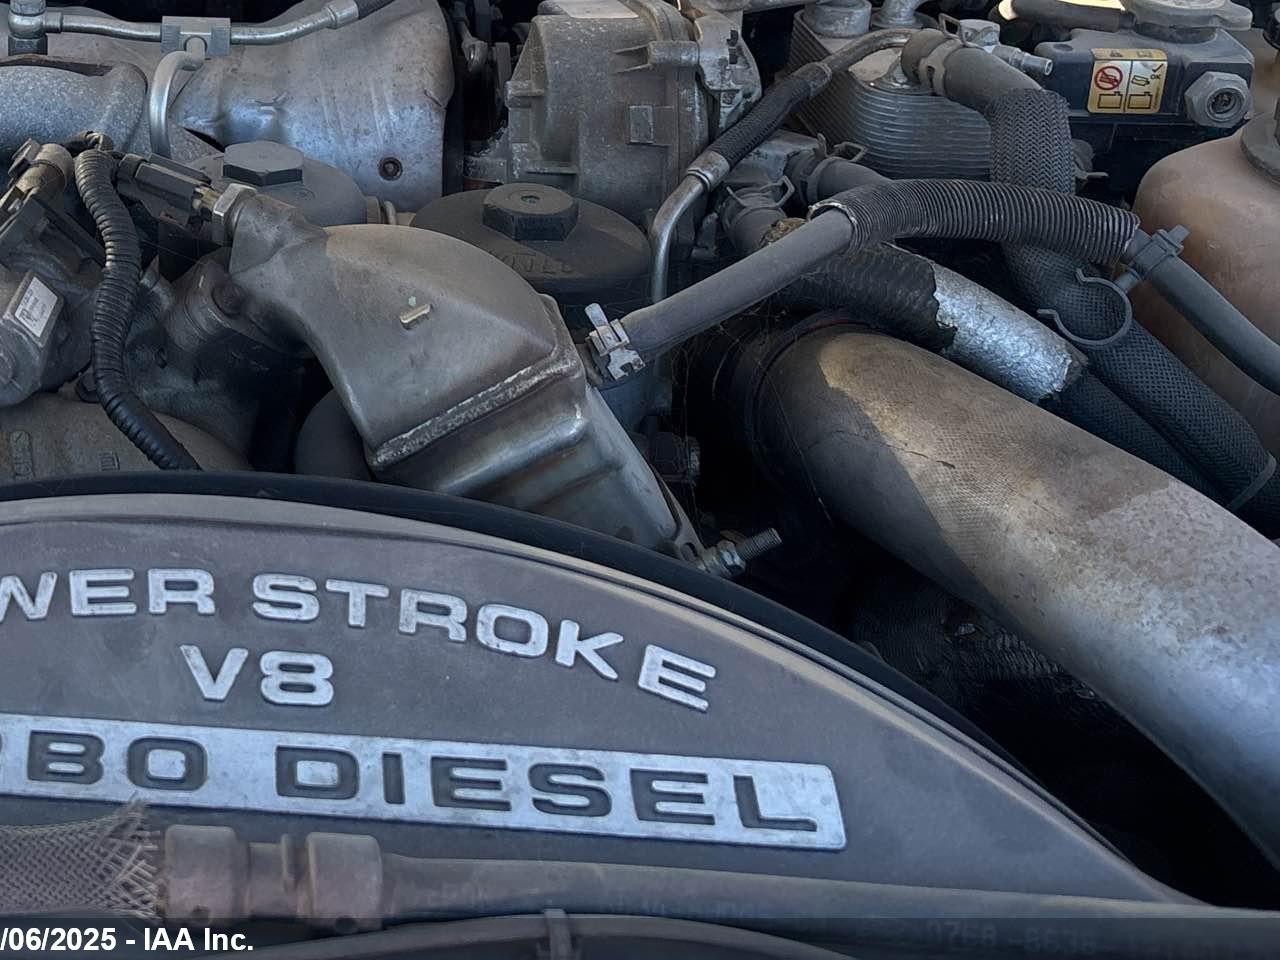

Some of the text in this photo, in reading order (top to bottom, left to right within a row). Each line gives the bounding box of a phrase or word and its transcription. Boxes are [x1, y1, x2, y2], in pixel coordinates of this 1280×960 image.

[179, 644, 334, 707] V8
[252, 573, 717, 713] STROKE
[274, 744, 818, 832] DIESEL
